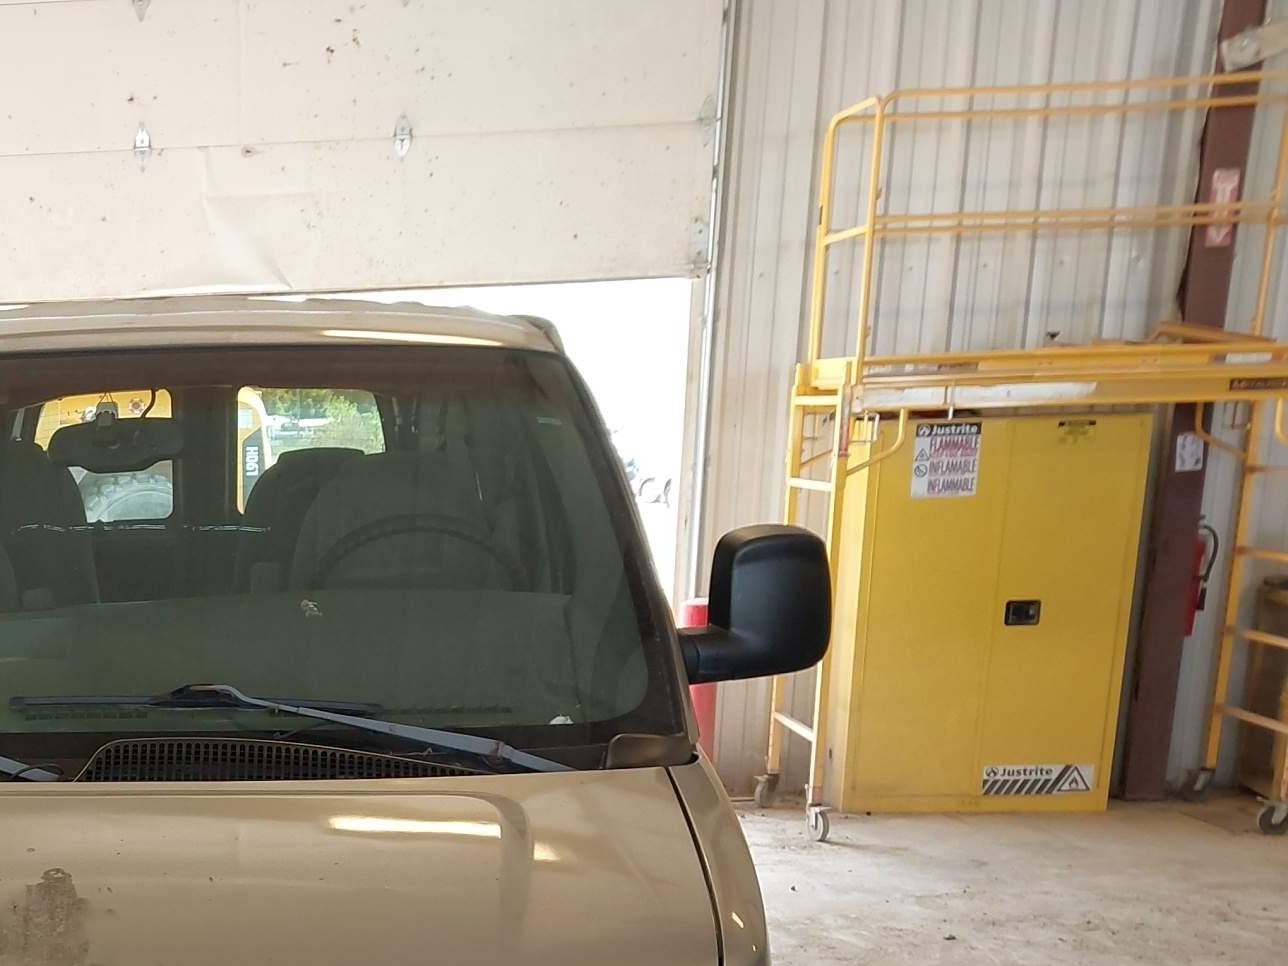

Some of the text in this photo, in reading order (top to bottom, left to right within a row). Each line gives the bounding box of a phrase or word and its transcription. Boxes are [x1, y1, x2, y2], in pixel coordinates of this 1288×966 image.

[932, 423, 978, 435] Justrite
[245, 446, 259, 476] L90H
[1000, 766, 1053, 777] Justrite
